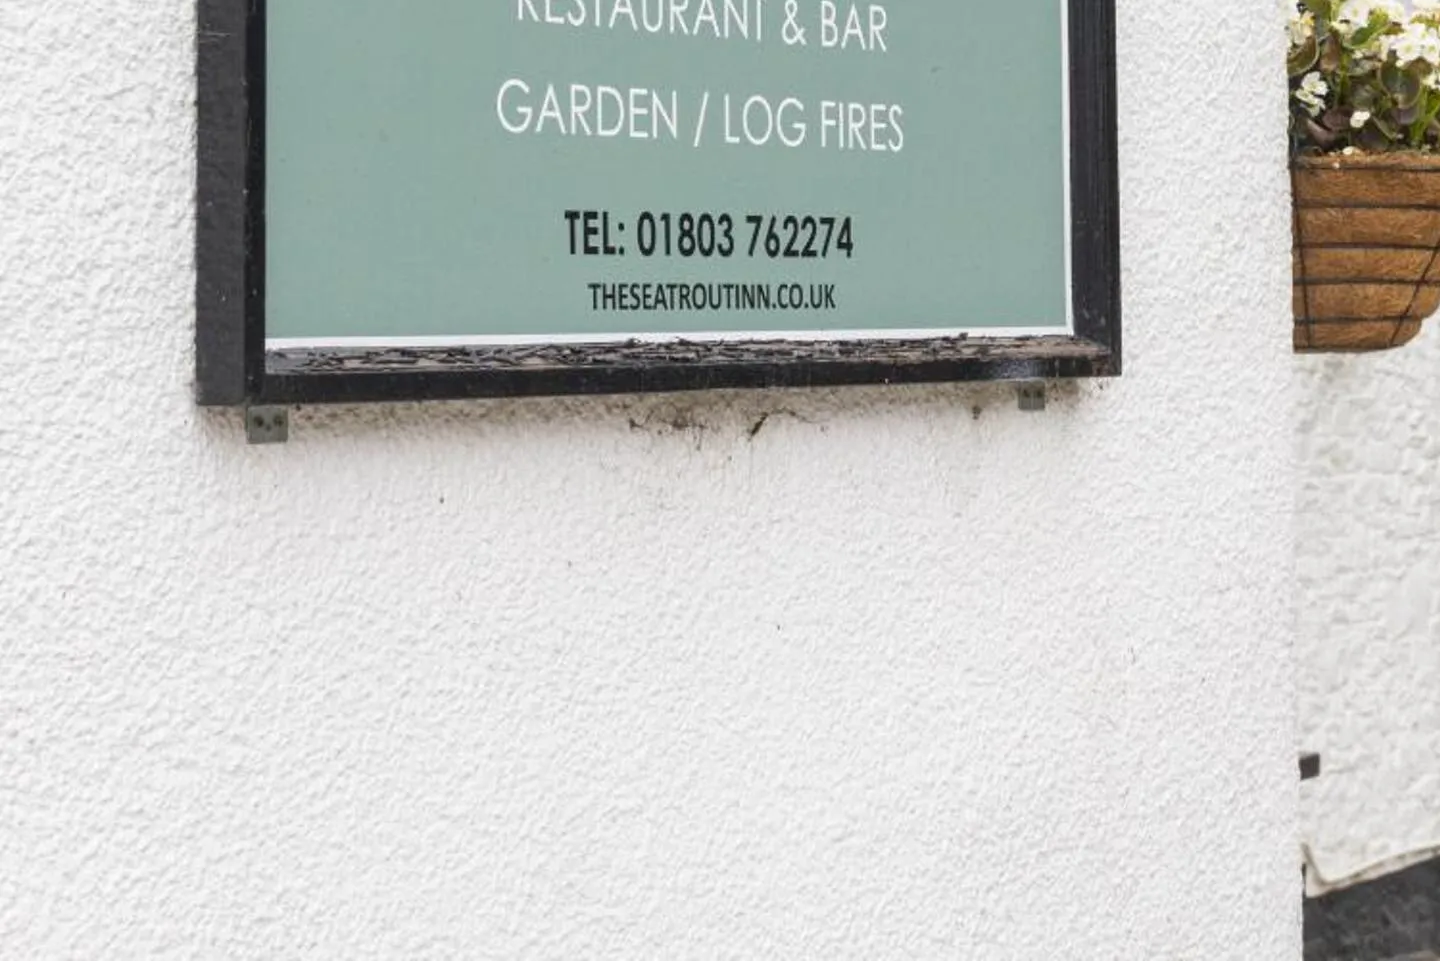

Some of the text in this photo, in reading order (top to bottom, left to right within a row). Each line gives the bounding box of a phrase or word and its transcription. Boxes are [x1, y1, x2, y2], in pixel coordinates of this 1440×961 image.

[820, 0, 889, 53] BAR
[496, 78, 904, 153] GARDEN / LOG FIRES
[563, 209, 855, 259] TEL: 01803 762274
[587, 282, 837, 312] THESEATROUTINN.CO.UK
